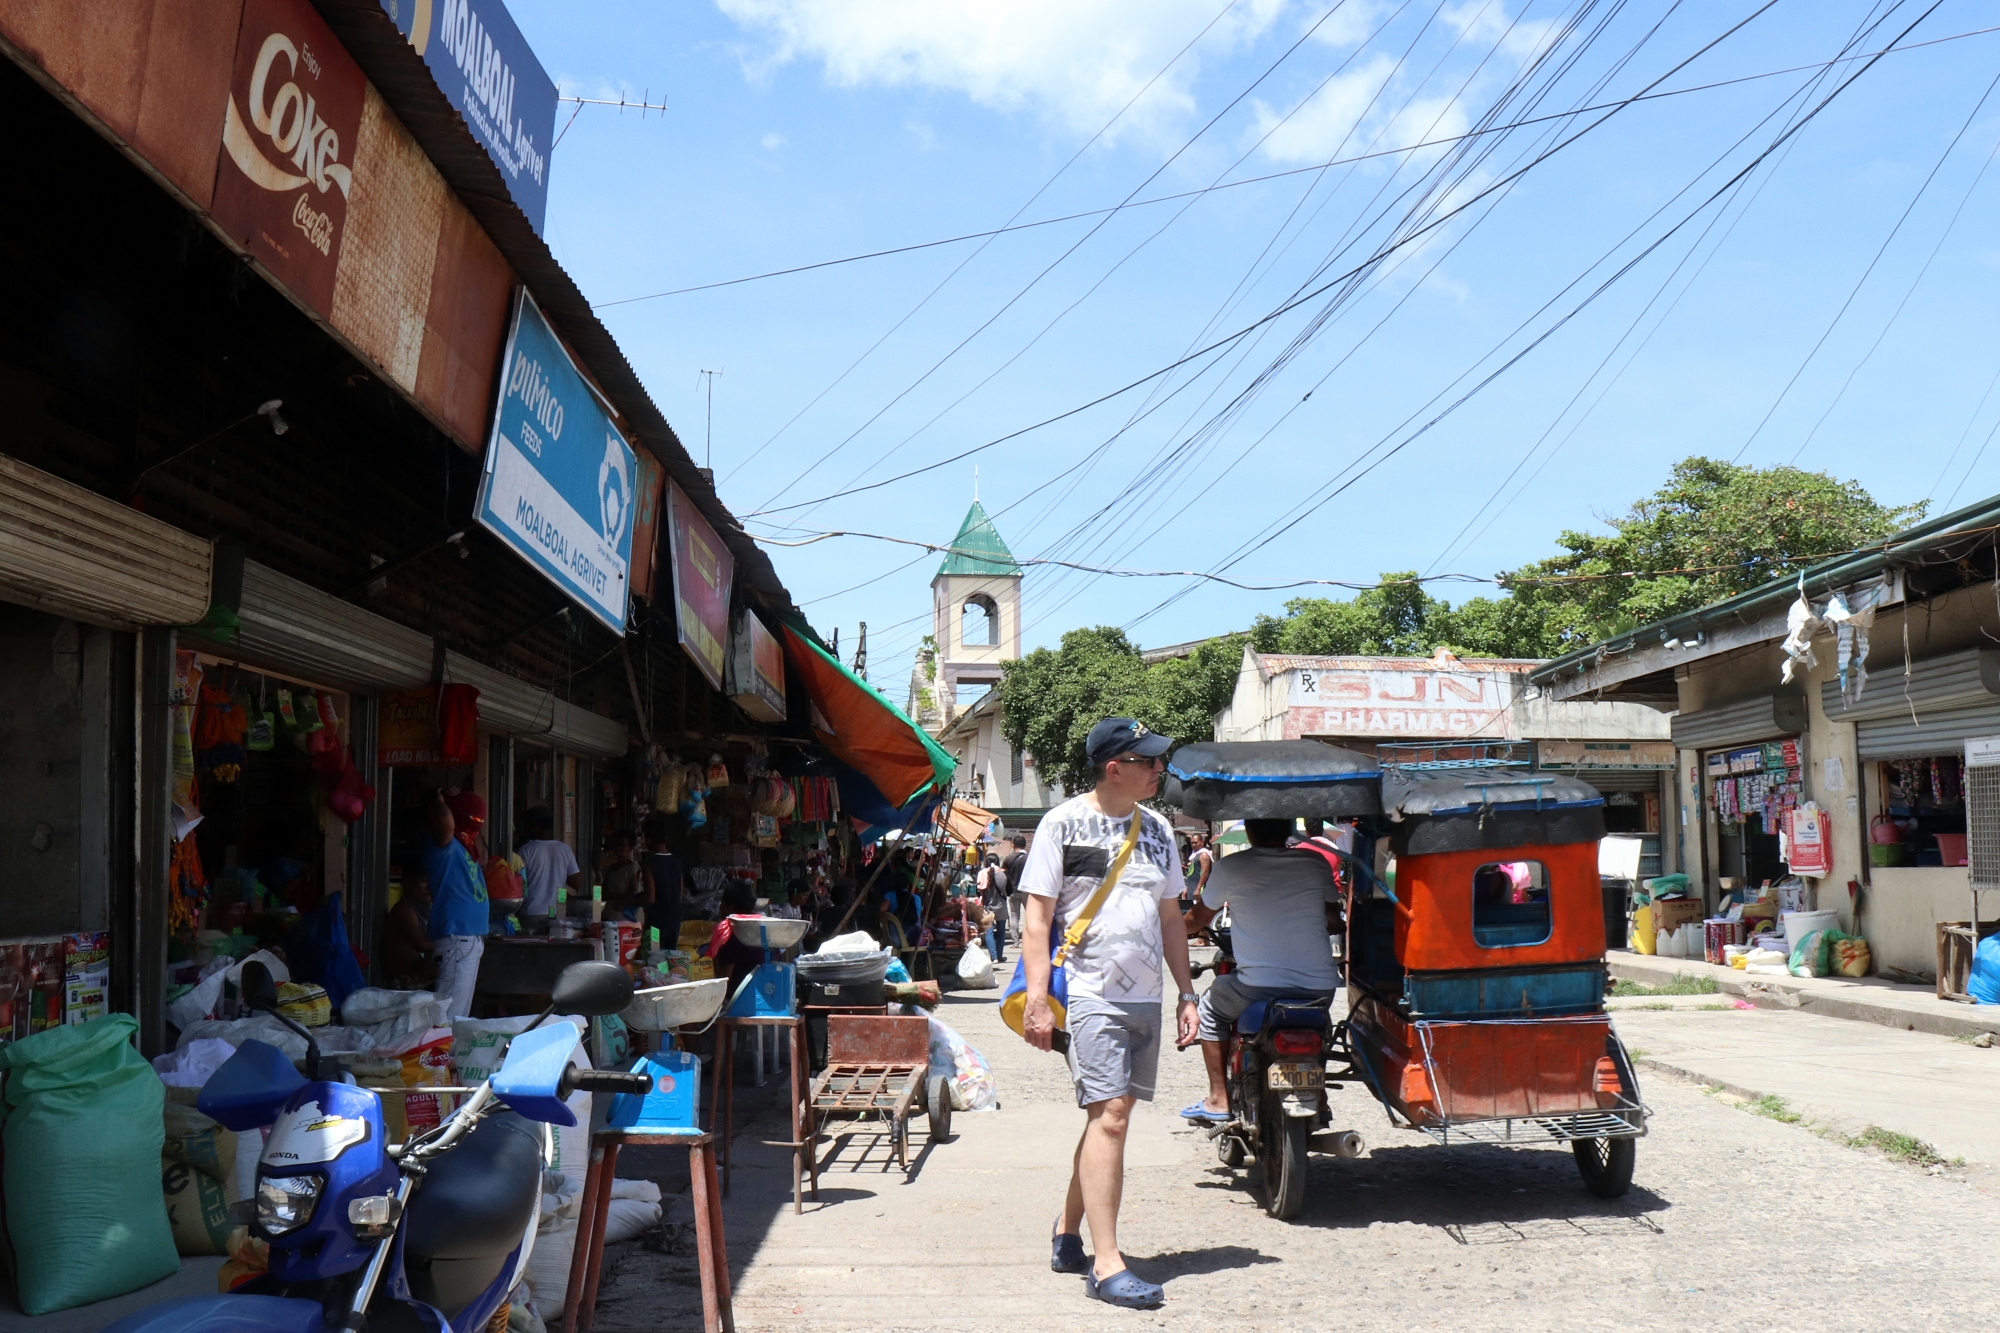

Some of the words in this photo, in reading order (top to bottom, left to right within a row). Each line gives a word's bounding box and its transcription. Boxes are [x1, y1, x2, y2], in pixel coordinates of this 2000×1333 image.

[301, 42, 321, 81] Enjoy
[441, 0, 515, 143] MOALBOAL
[514, 118, 543, 187] Agrivet
[238, 33, 352, 198] Coke
[521, 420, 542, 458] FEEDS
[516, 494, 569, 565] MOALBOAL
[570, 546, 607, 597] AGRIVET
[1318, 674, 1486, 703] SJN
[1324, 711, 1488, 732] PHARMACY
[385, 751, 413, 764] LOAD
[416, 750, 431, 763] NA
[65, 952, 91, 964] BAGONG
[1272, 1072, 1303, 1087] 3200
[405, 1092, 436, 1104] ADULT
[268, 1152, 300, 1160] HONDA
